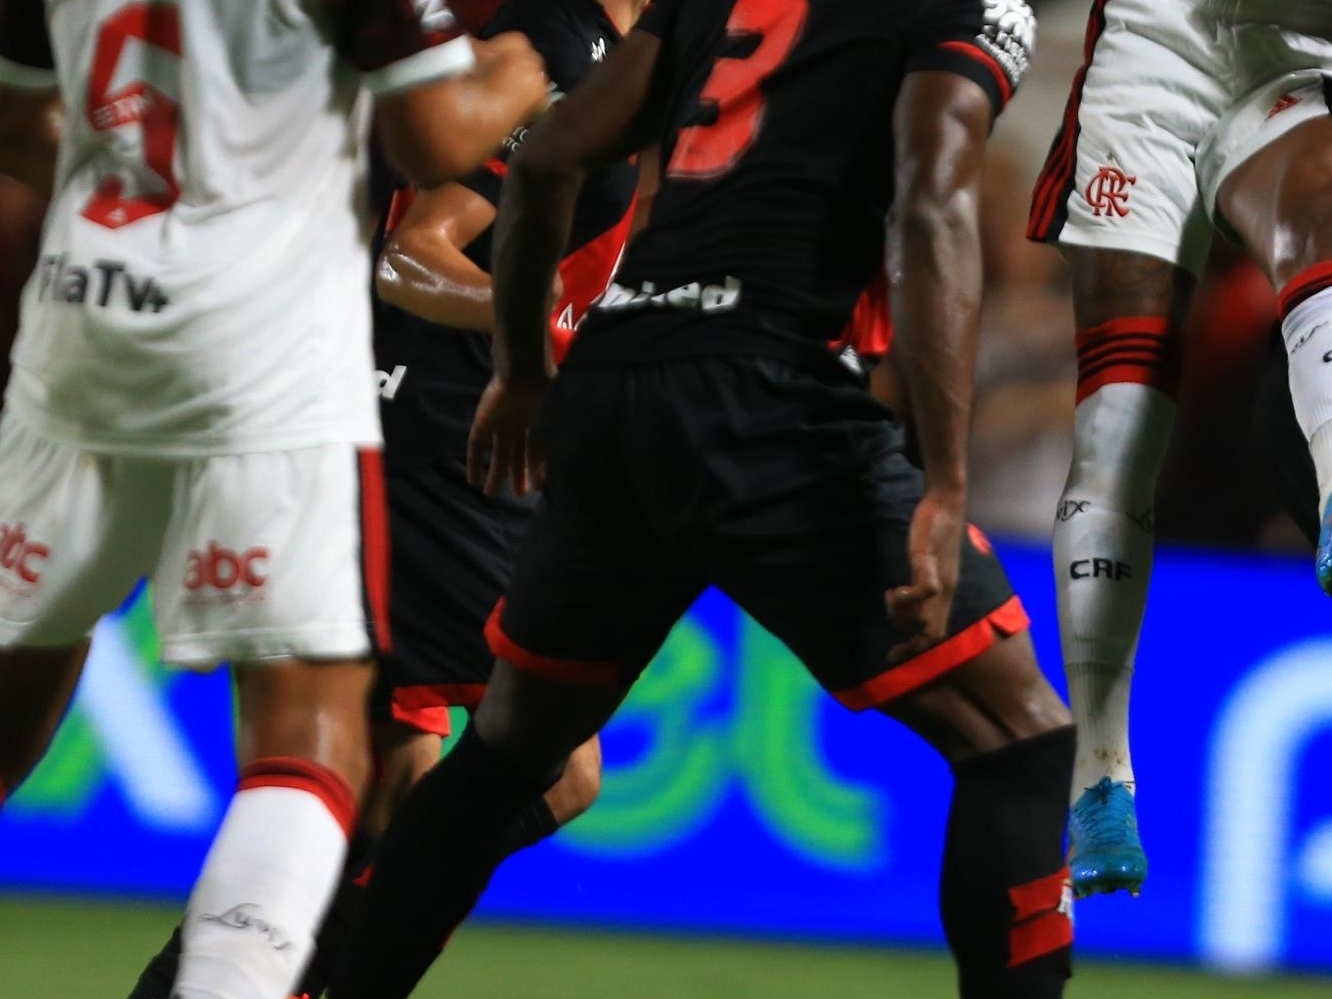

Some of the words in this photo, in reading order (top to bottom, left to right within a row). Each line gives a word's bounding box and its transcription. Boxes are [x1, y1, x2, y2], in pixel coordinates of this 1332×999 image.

[78, 0, 185, 231] 5
[183, 538, 270, 590] abc
[1069, 556, 1133, 581] CRF
